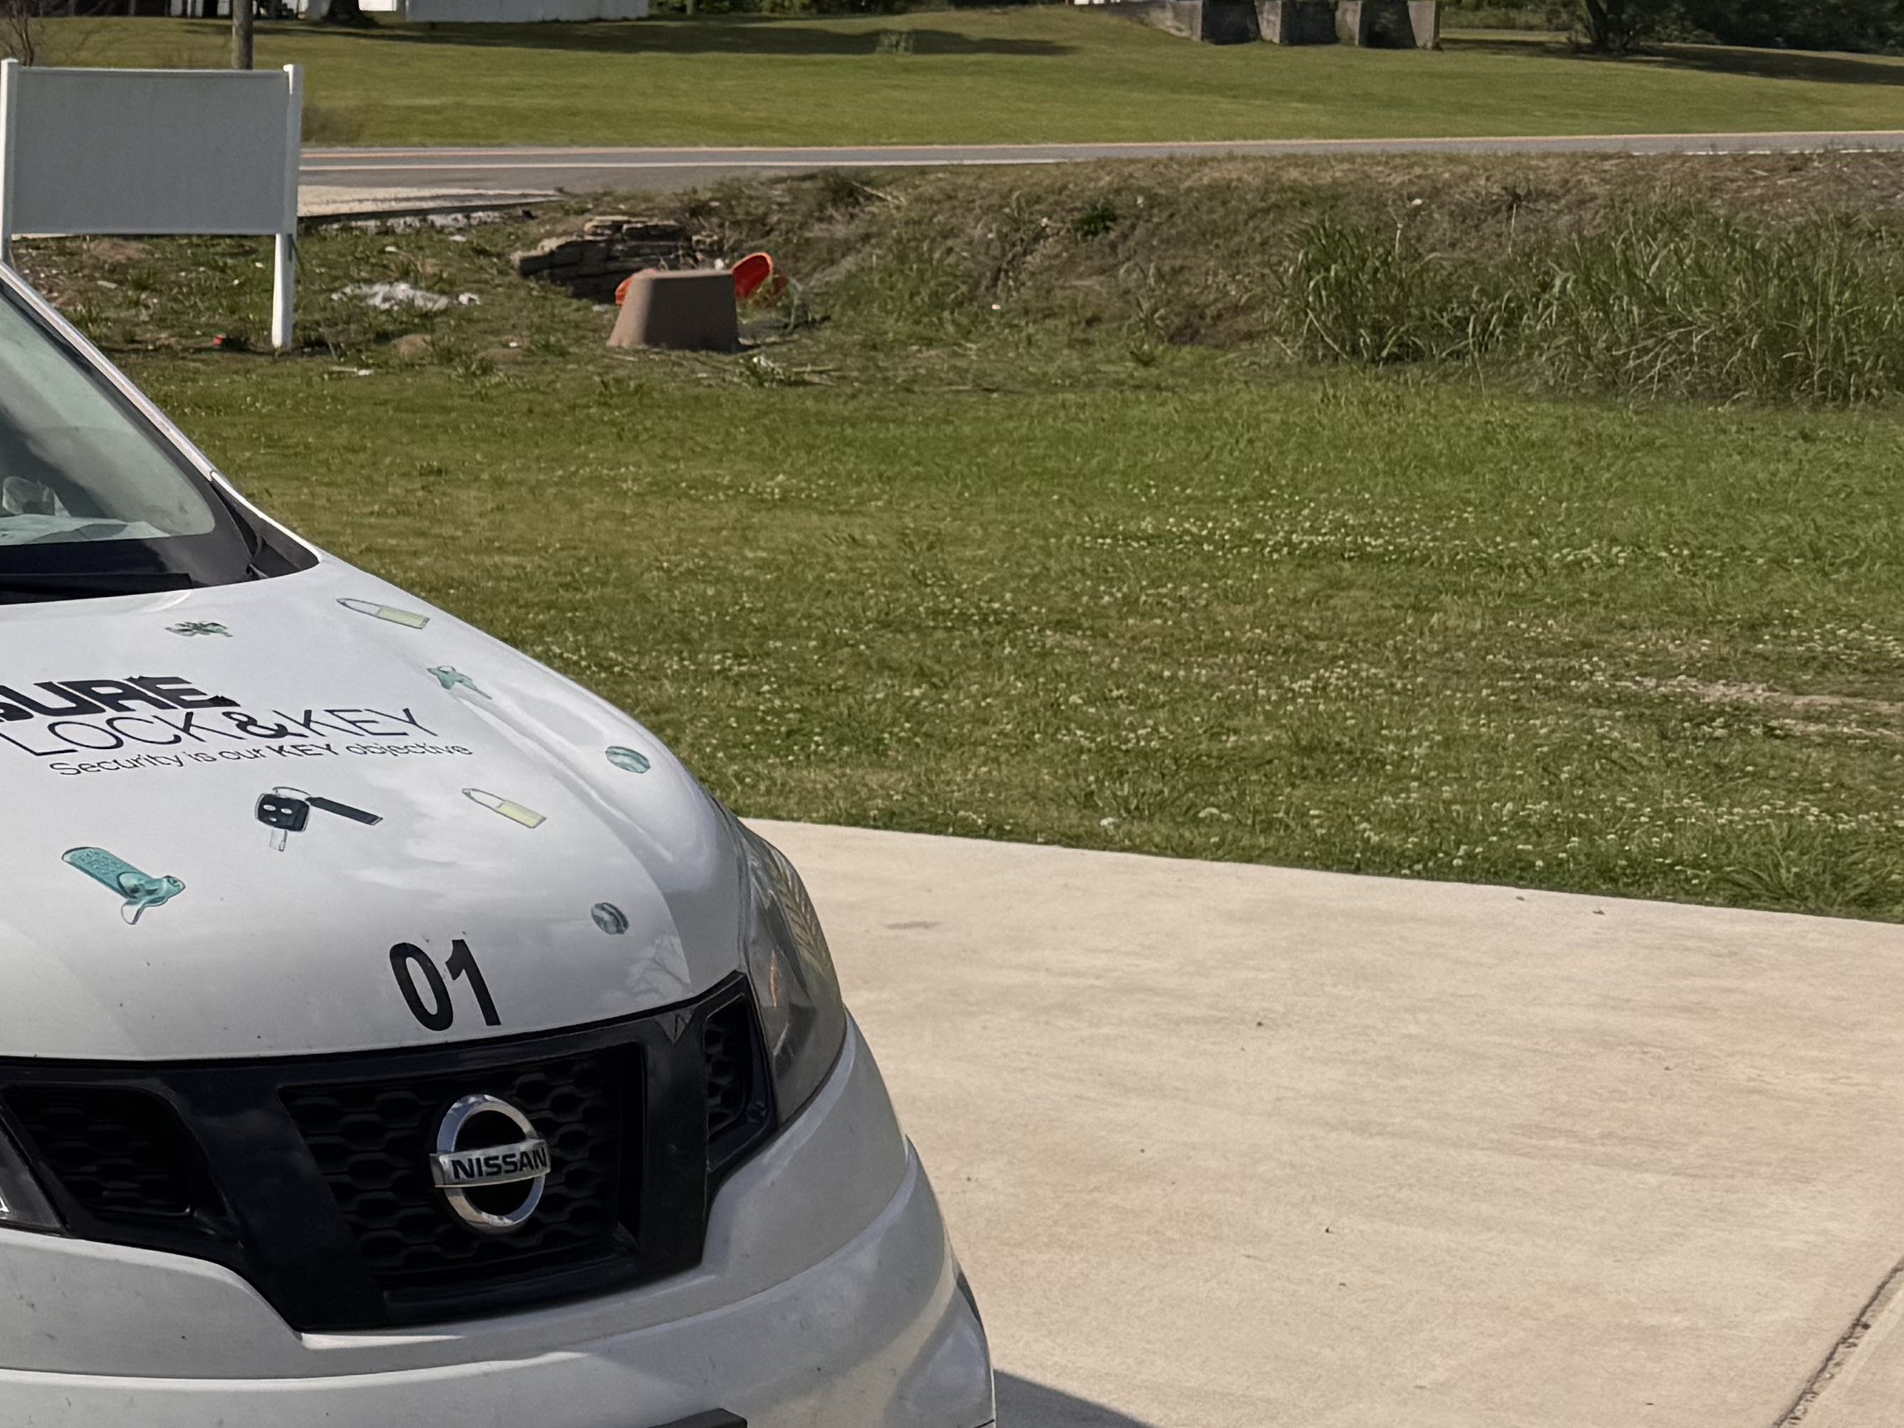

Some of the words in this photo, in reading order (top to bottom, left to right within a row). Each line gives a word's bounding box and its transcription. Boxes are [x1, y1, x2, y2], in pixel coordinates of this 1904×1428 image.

[49, 753, 185, 776] Security
[189, 750, 213, 764] is
[217, 748, 270, 763] our
[270, 742, 338, 758] KEY
[345, 741, 474, 758] objective
[389, 939, 501, 1030] 01
[449, 1144, 551, 1182] NISSAN
